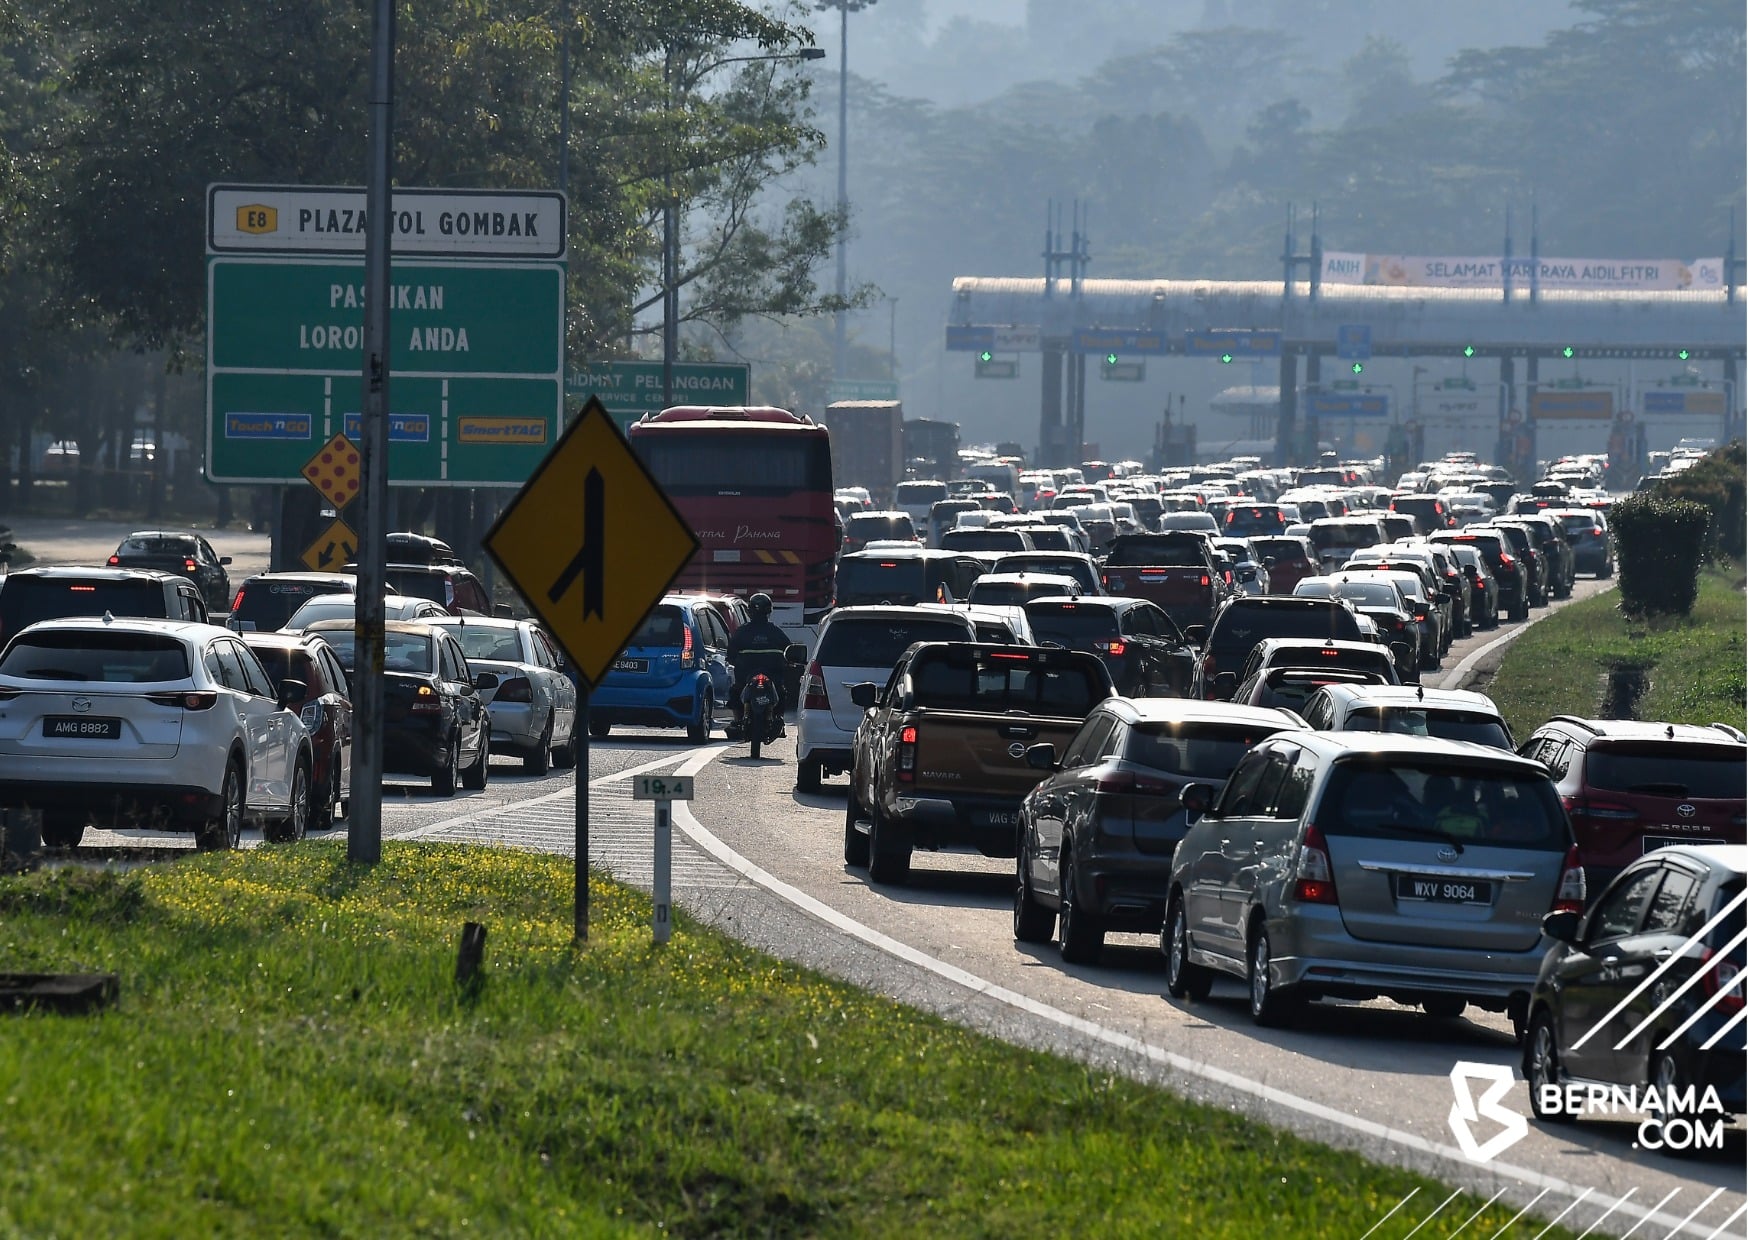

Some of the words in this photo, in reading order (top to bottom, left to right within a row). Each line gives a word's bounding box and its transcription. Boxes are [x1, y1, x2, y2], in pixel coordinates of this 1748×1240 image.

[248, 211, 267, 228] E8
[299, 209, 367, 234] PLAZA
[439, 212, 538, 237] GOMBAK
[1327, 260, 1359, 273] ANIH
[1425, 264, 1495, 278] SELAMAT
[1541, 265, 1576, 279] RAYA
[1581, 266, 1659, 280] AIDILFITRI
[330, 284, 444, 309] PAIKAN
[300, 325, 364, 350] LORO
[409, 327, 469, 351] ANDA
[635, 376, 734, 391] PELNGGAN
[55, 721, 78, 733] AMG
[80, 722, 109, 734] 8882
[922, 770, 962, 781] NAVARA
[989, 812, 1008, 824] VAG
[1414, 881, 1438, 897] WXV
[1443, 883, 1475, 899] 9064
